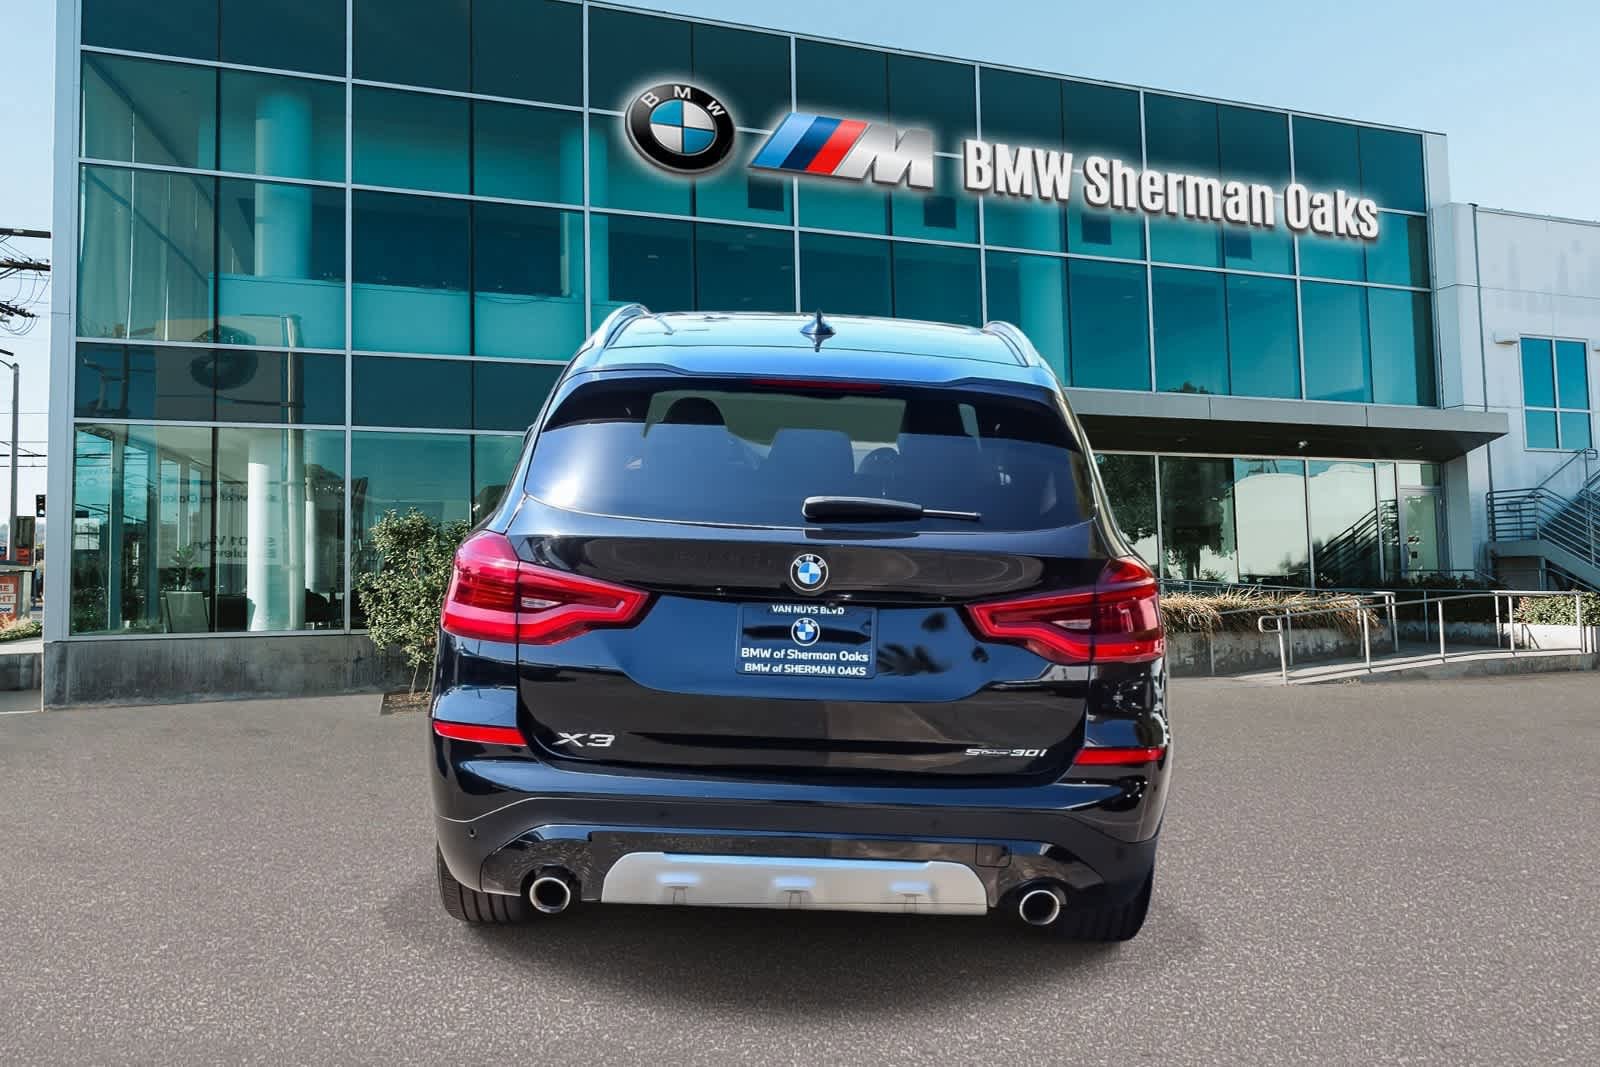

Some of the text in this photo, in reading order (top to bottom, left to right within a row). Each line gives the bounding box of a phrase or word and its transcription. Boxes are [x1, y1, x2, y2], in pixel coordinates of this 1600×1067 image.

[640, 85, 726, 117] BMW
[963, 140, 1379, 240] BMW Sherman Oaks
[795, 555, 826, 568] BMW
[772, 604, 845, 615] VAN NUYS BLVD
[741, 648, 869, 662] BMW of Sherman Oaks
[744, 662, 867, 676] BMW of SHERMAN OAKS
[552, 732, 616, 747] X3
